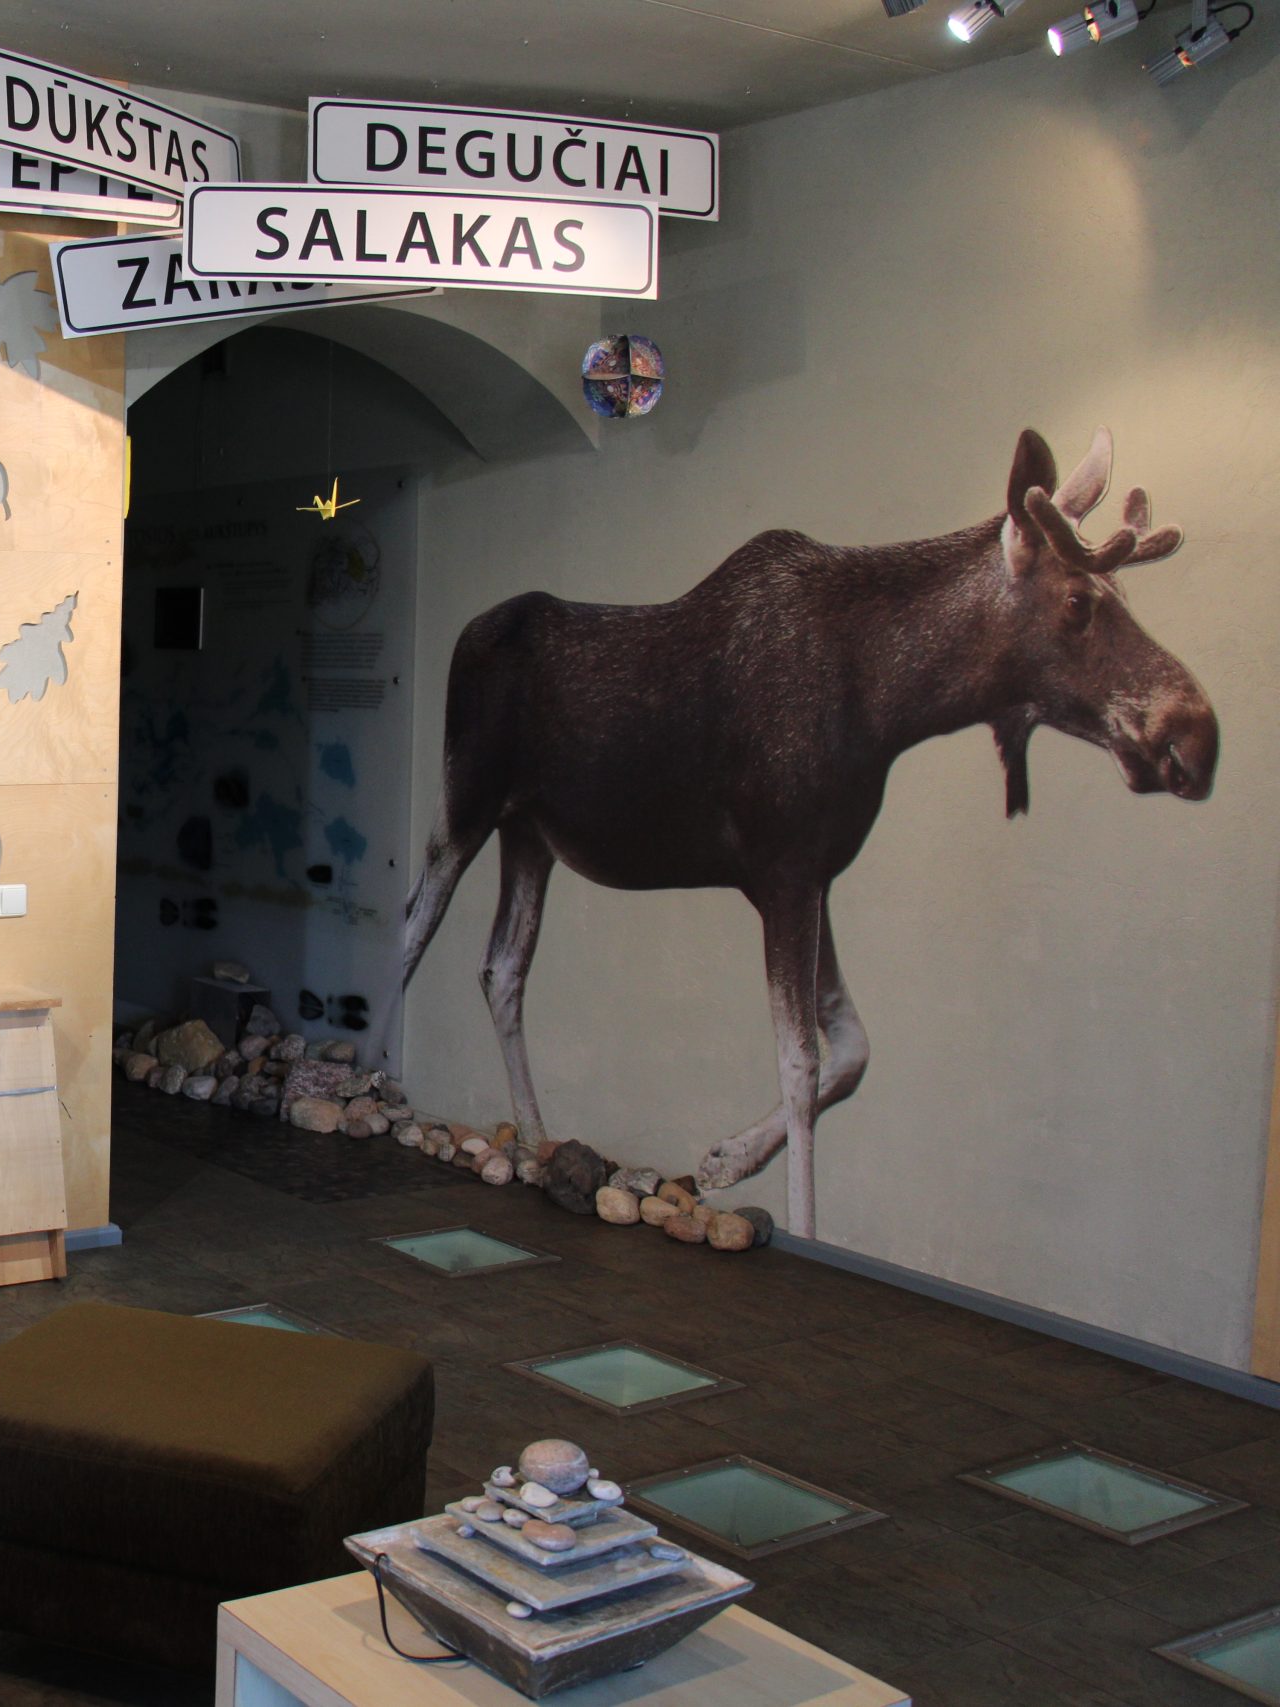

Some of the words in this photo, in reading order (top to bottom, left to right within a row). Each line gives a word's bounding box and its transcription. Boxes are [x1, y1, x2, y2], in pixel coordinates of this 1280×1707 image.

[6, 75, 210, 183] DŪKŠTAS
[366, 122, 669, 197] DEGUČIAI
[255, 206, 586, 273] SALAKAS
